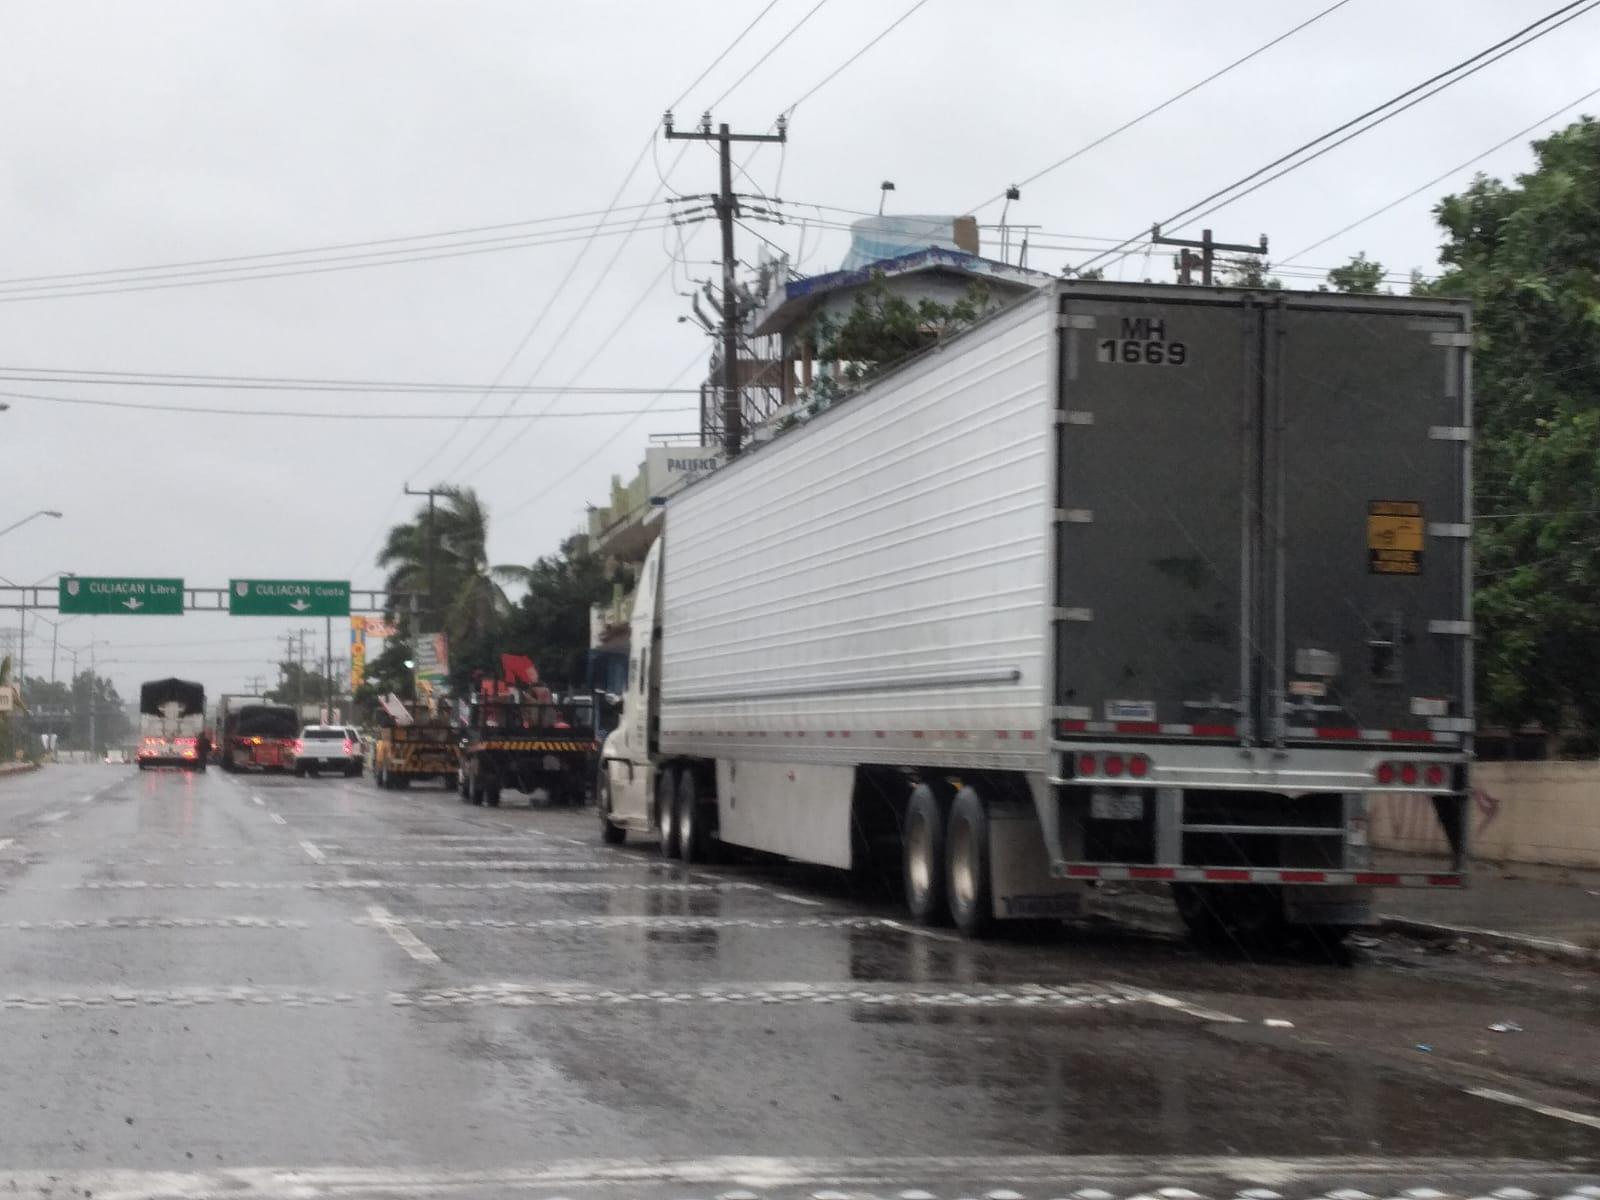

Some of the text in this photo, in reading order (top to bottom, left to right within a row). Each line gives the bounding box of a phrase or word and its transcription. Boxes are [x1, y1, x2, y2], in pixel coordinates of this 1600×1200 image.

[1121, 317, 1166, 340] MH
[1100, 339, 1187, 365] 1669
[89, 583, 177, 595] CULIACAN Libre
[256, 584, 346, 598] CULIACAN Cuota
